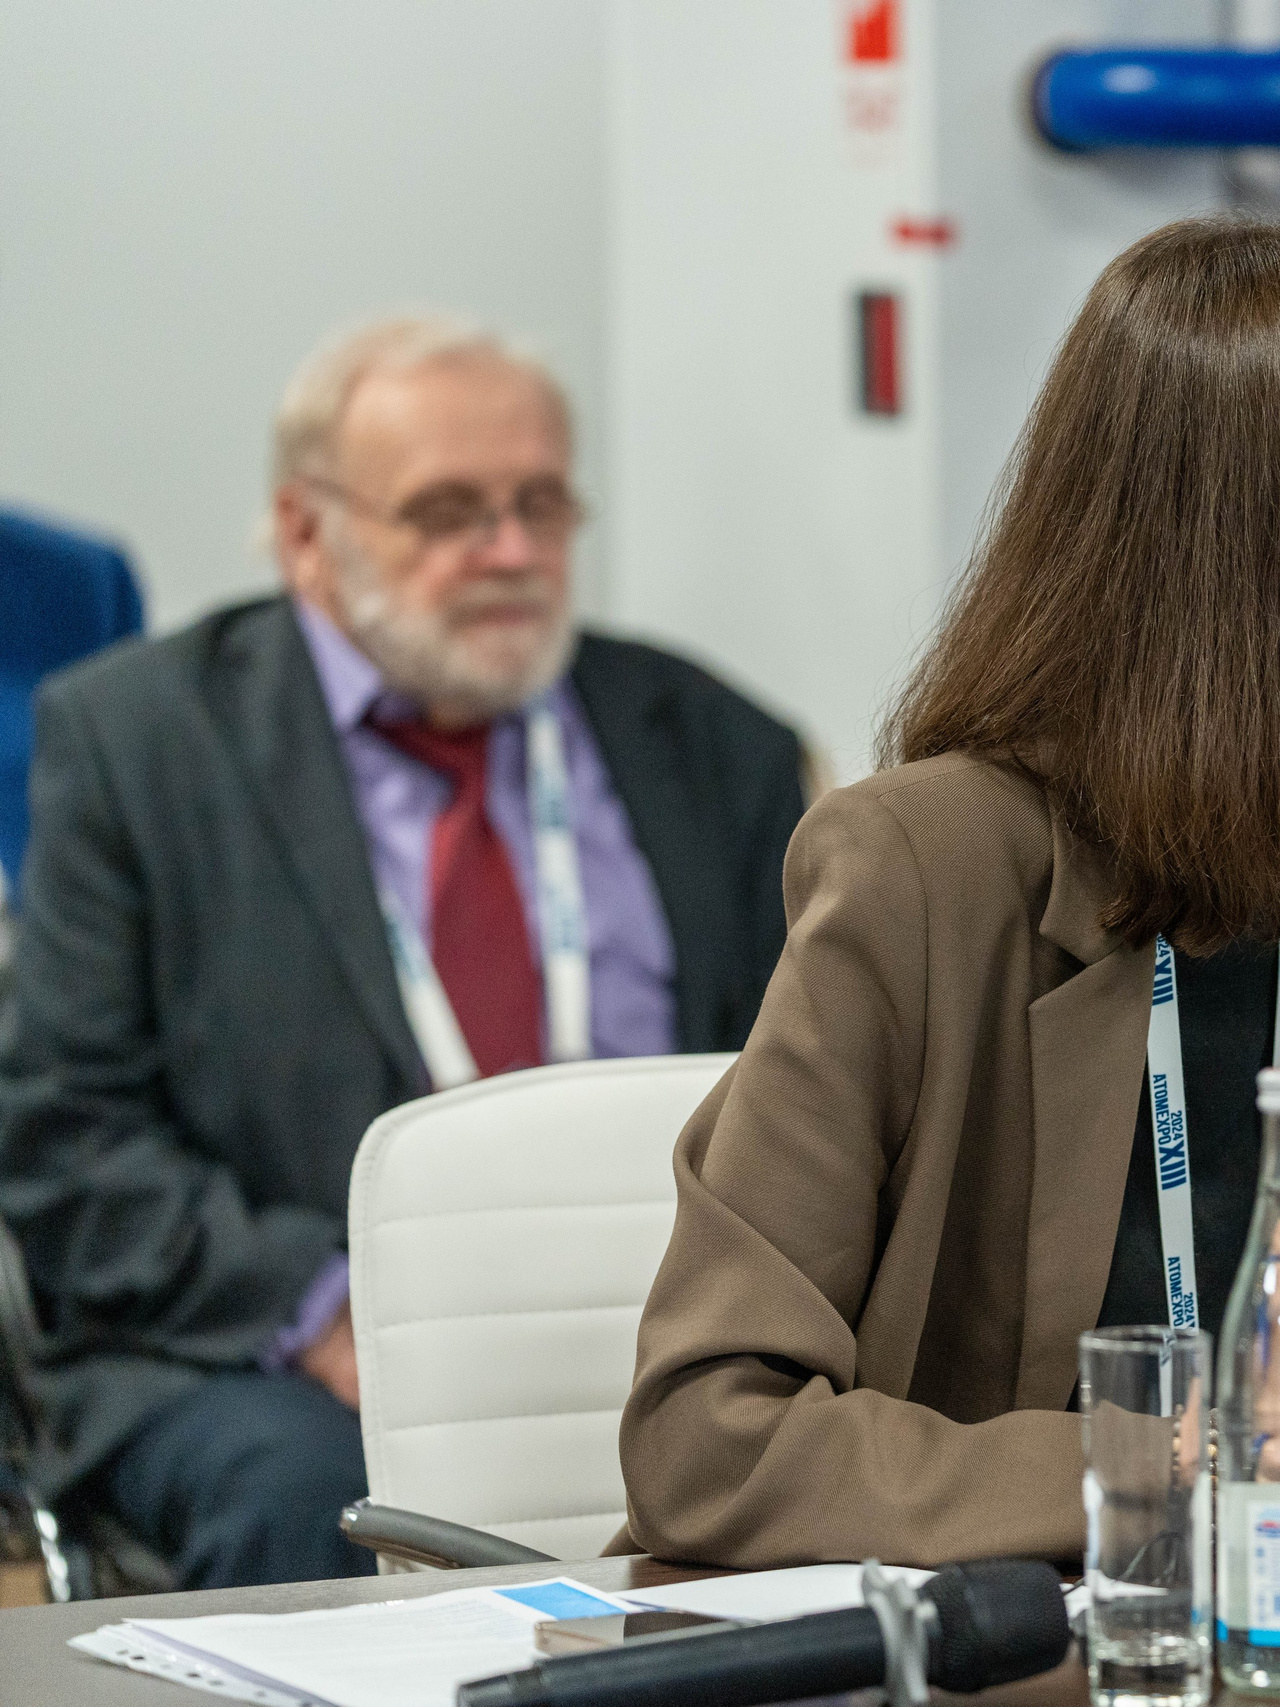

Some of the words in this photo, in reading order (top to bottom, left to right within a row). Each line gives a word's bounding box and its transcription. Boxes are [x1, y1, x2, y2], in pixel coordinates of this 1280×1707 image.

[1153, 1073, 1172, 1146] ATOMEXPO
[1170, 1110, 1184, 1141] 2024
[1159, 1139, 1187, 1191] XIII
[1168, 1256, 1184, 1327] ATOMEXPO
[1184, 1291, 1195, 1323] 2024
